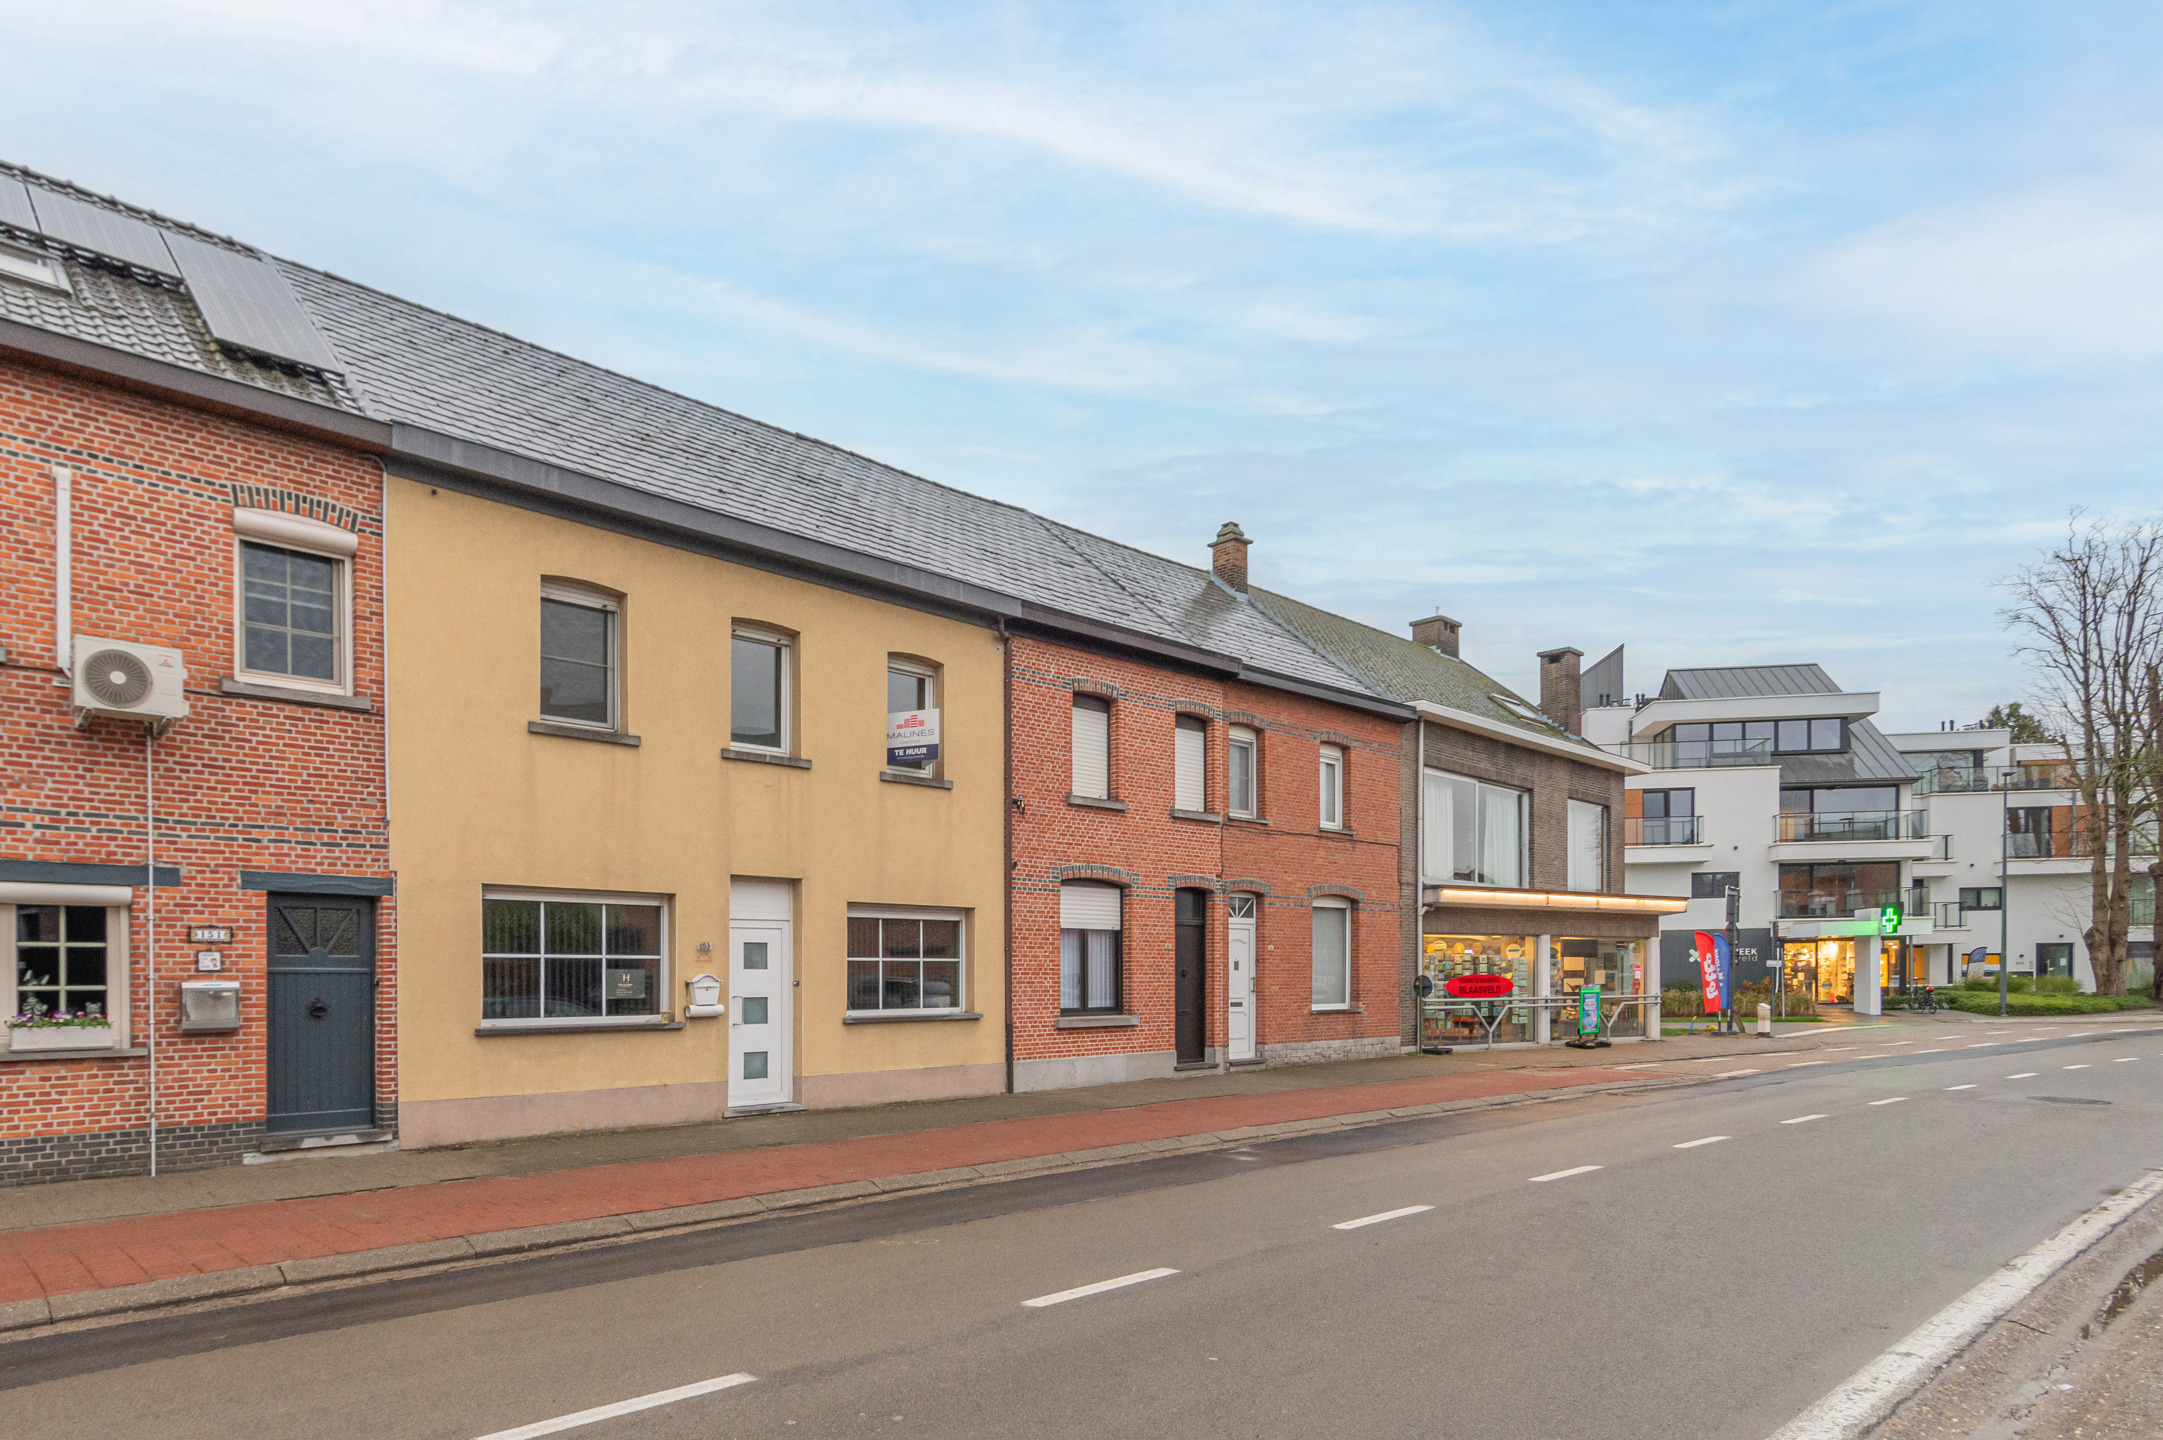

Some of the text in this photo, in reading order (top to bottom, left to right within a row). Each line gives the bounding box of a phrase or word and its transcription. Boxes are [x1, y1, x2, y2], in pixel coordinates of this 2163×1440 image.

[887, 729, 934, 739] MALINES
[905, 747, 927, 755] HUUR
[201, 930, 221, 938] 151
[622, 973, 630, 982] H
[1459, 985, 1501, 994] BLAASVELD
